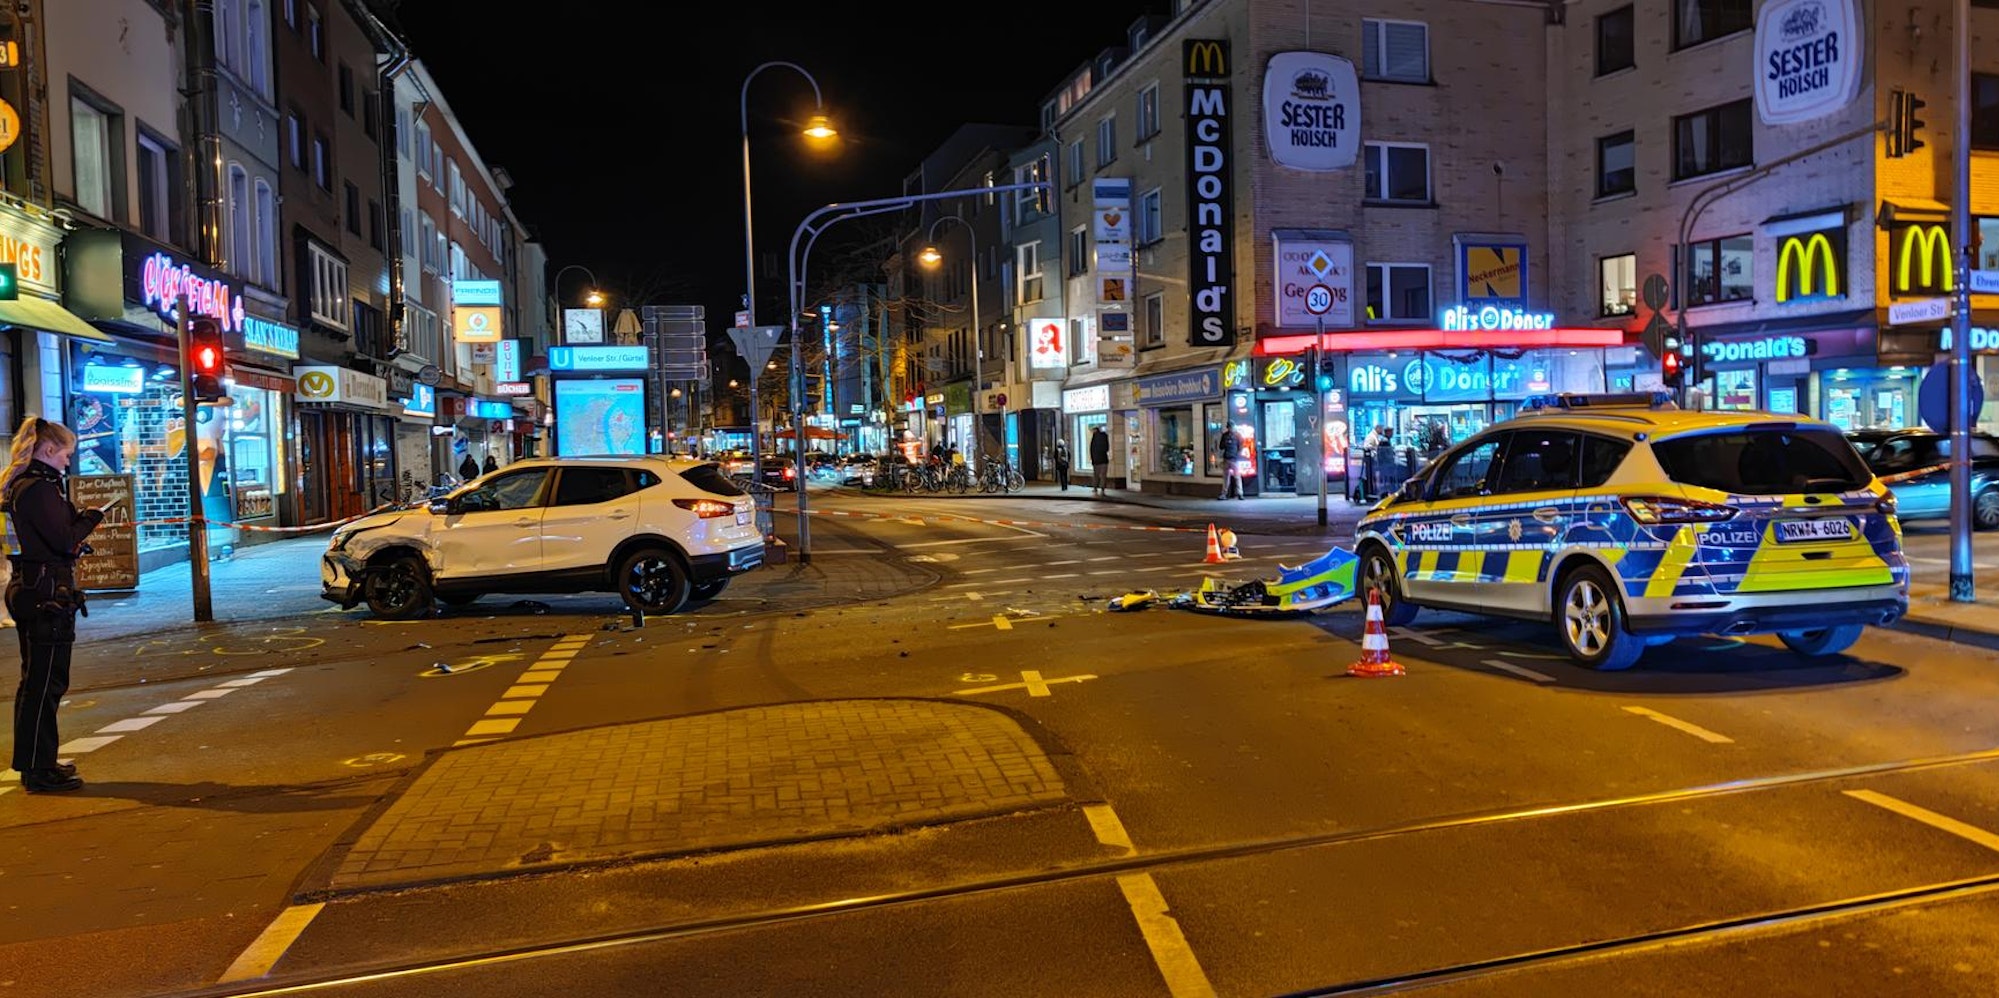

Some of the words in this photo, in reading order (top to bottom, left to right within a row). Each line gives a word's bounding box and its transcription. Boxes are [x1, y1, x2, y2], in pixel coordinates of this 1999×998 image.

[1768, 31, 1839, 81] SESTER
[1779, 67, 1829, 99] KÖLSCH
[1281, 100, 1345, 130] SESTER
[1291, 129, 1337, 148] KÖLSCH
[1190, 88, 1226, 342] McDonald's
[1310, 292, 1328, 307] 30
[1444, 305, 1479, 331] Ali's
[1500, 309, 1554, 330] Döner
[1894, 305, 1928, 320] Venloer
[1930, 303, 1946, 316] Str.
[553, 349, 570, 367] U
[1351, 364, 1398, 393] Ali's
[1440, 366, 1513, 391] Döner
[1411, 523, 1453, 541] POLIZEI
[1700, 531, 1758, 545] POLIZEI
[1783, 523, 1806, 538] NRW
